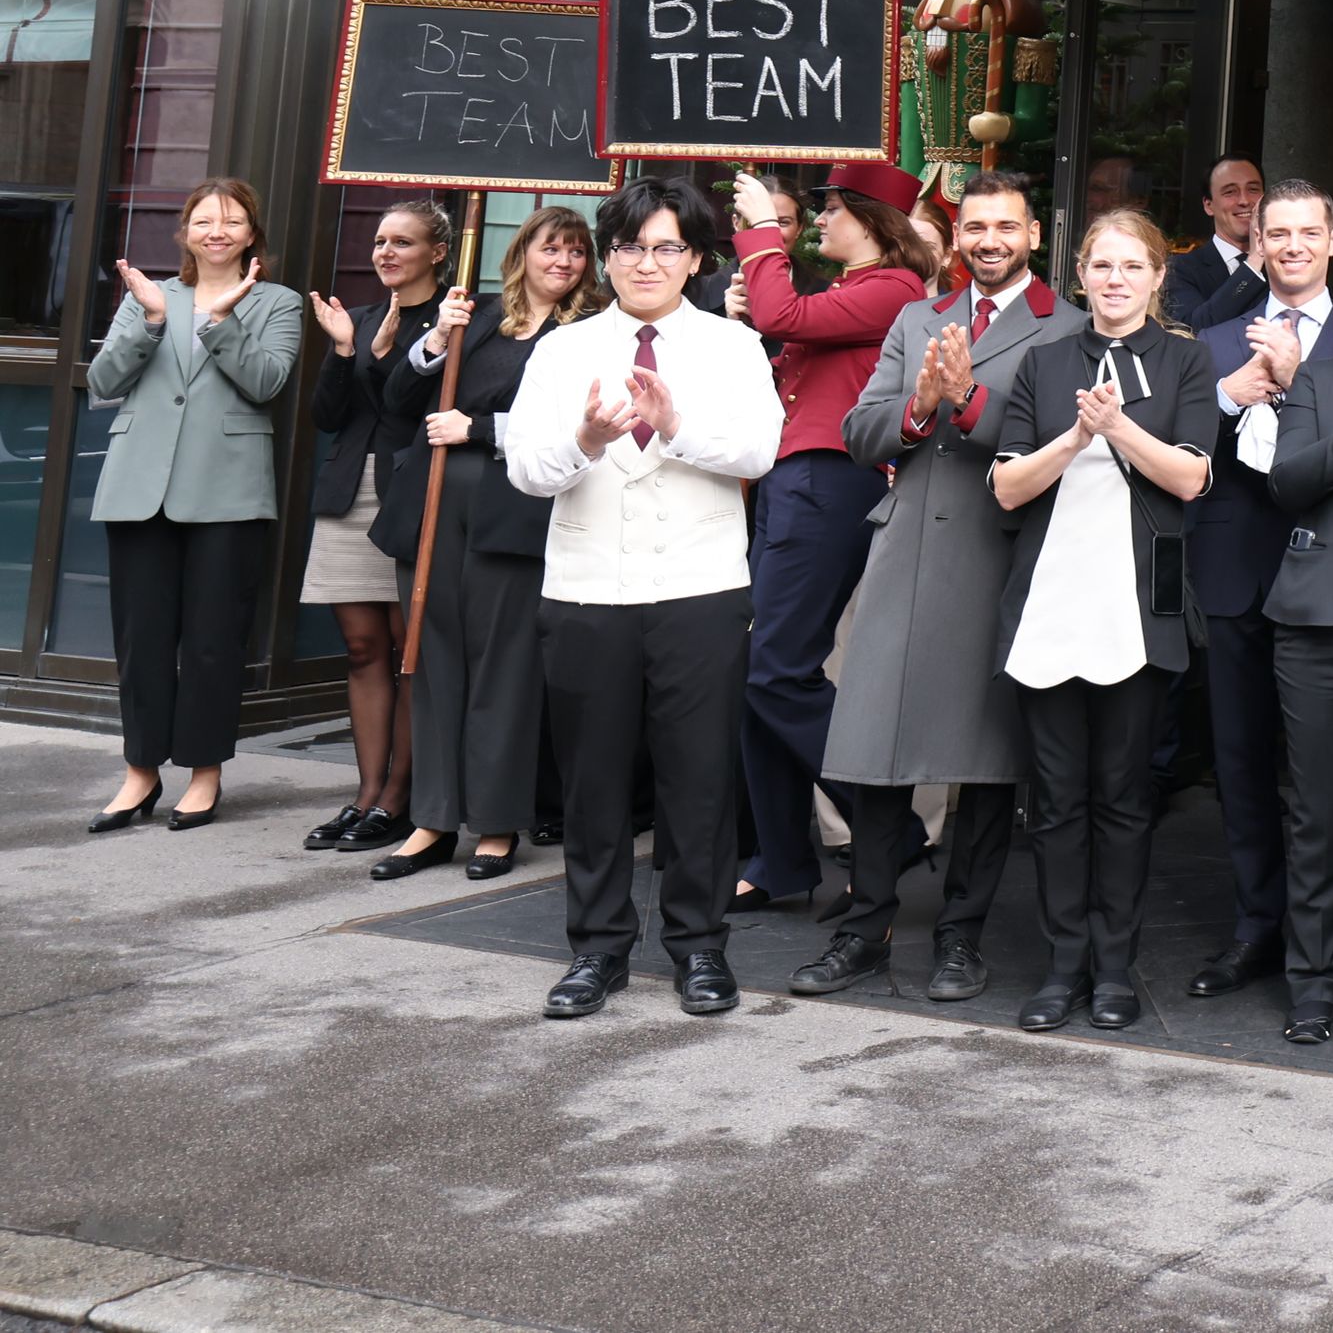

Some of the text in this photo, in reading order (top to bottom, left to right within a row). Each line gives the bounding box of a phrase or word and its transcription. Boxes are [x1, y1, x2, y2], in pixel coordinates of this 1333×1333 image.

[414, 23, 585, 87] BEST
[650, 52, 843, 123] TEAM
[402, 91, 594, 158] TEAM
